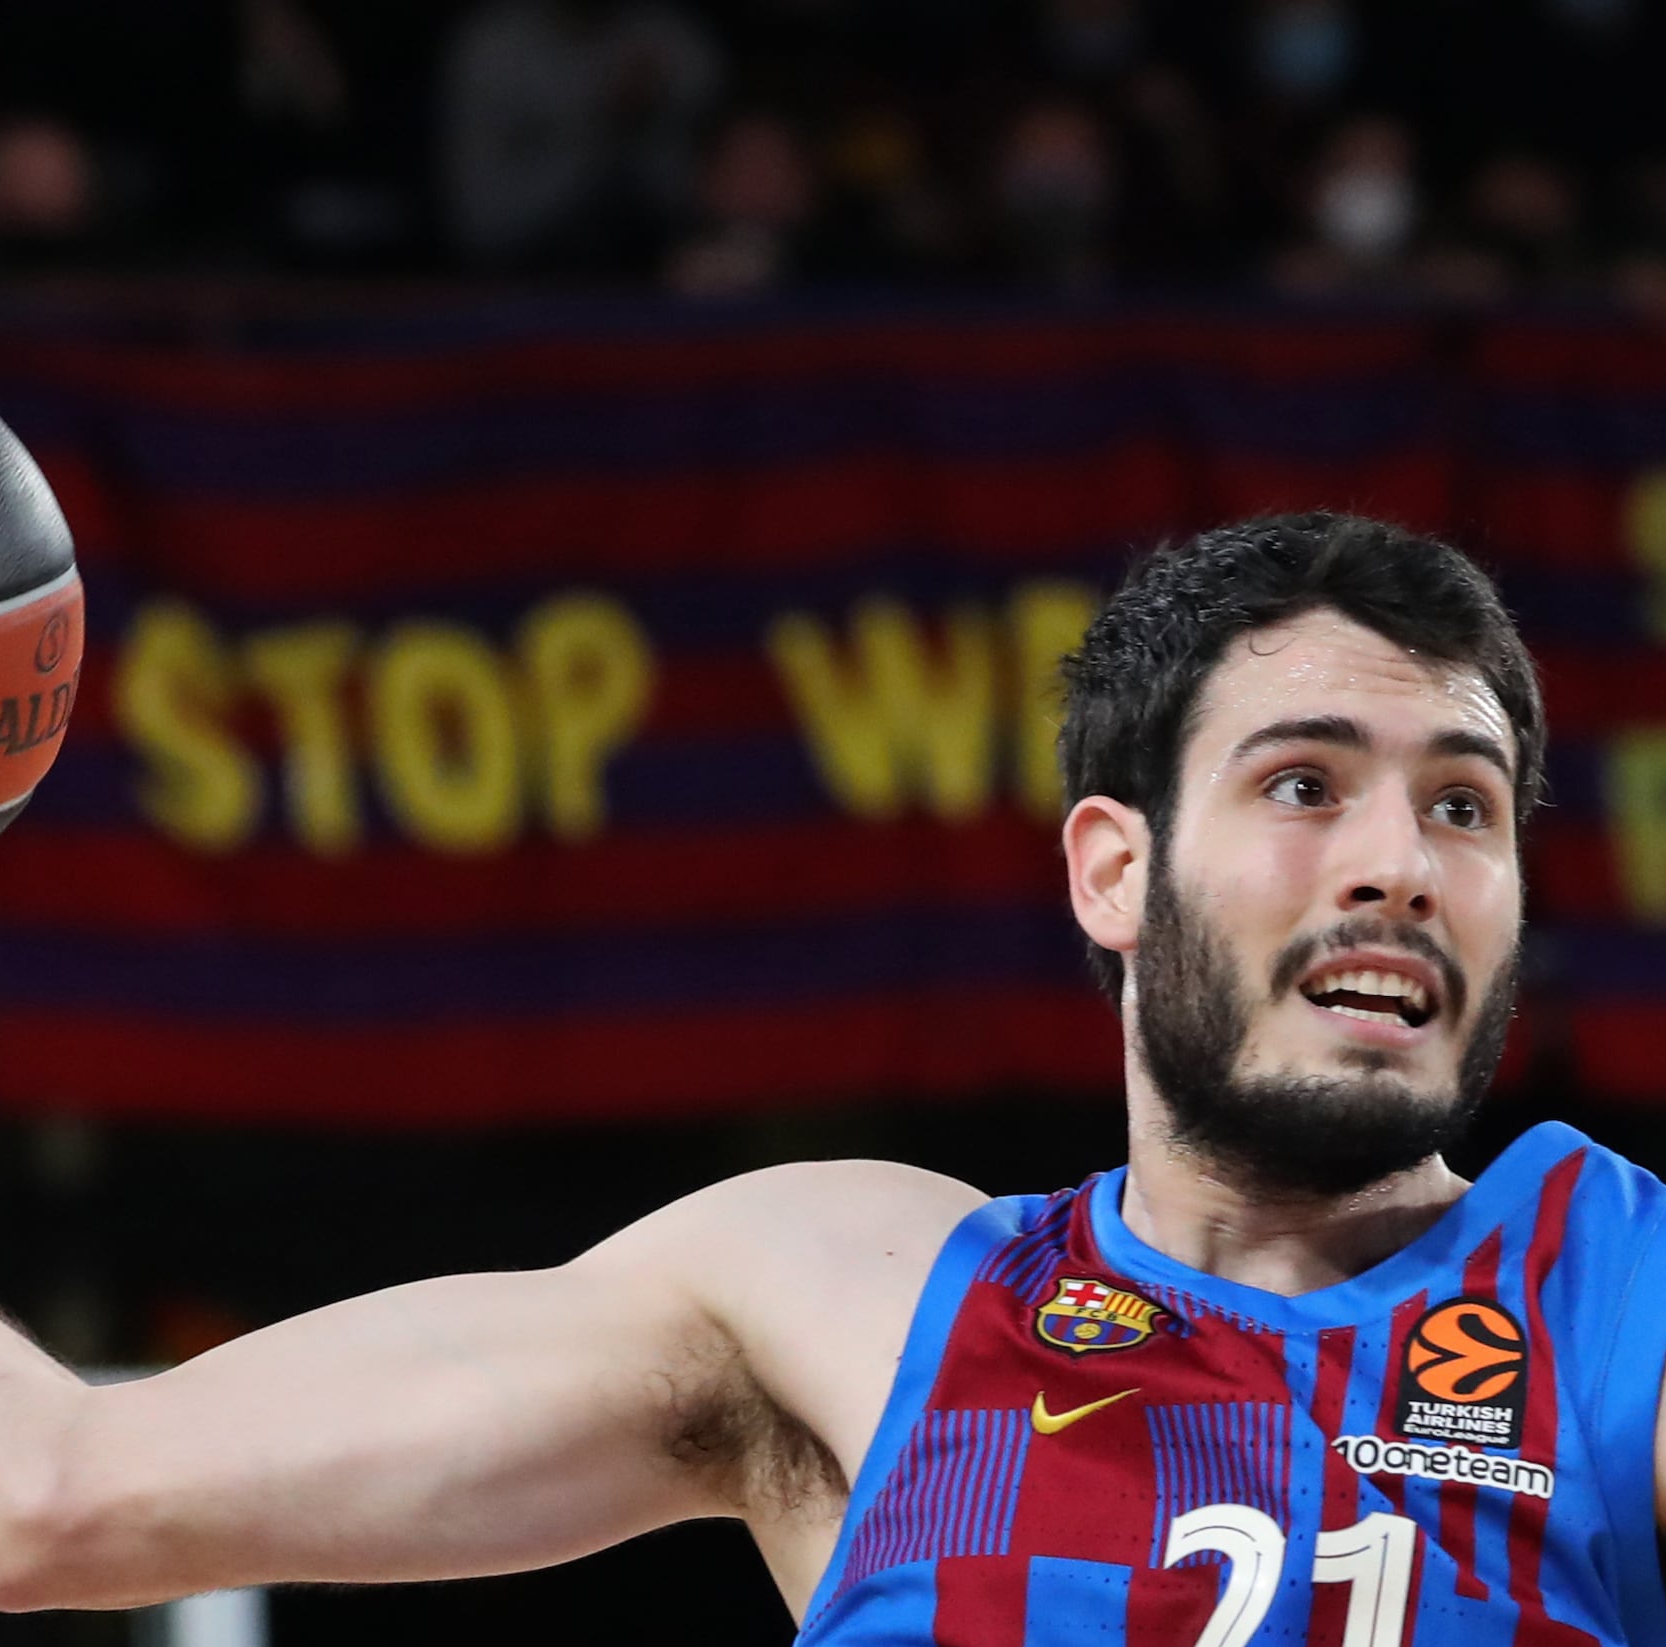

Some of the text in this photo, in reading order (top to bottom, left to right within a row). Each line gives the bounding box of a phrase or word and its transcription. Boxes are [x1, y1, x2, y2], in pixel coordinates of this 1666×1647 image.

[119, 590, 649, 856] STOP
[1408, 1401, 1514, 1421] TURKISH
[1403, 1423, 1510, 1445] EuroLeague
[1406, 1414, 1512, 1434] AIRLINES
